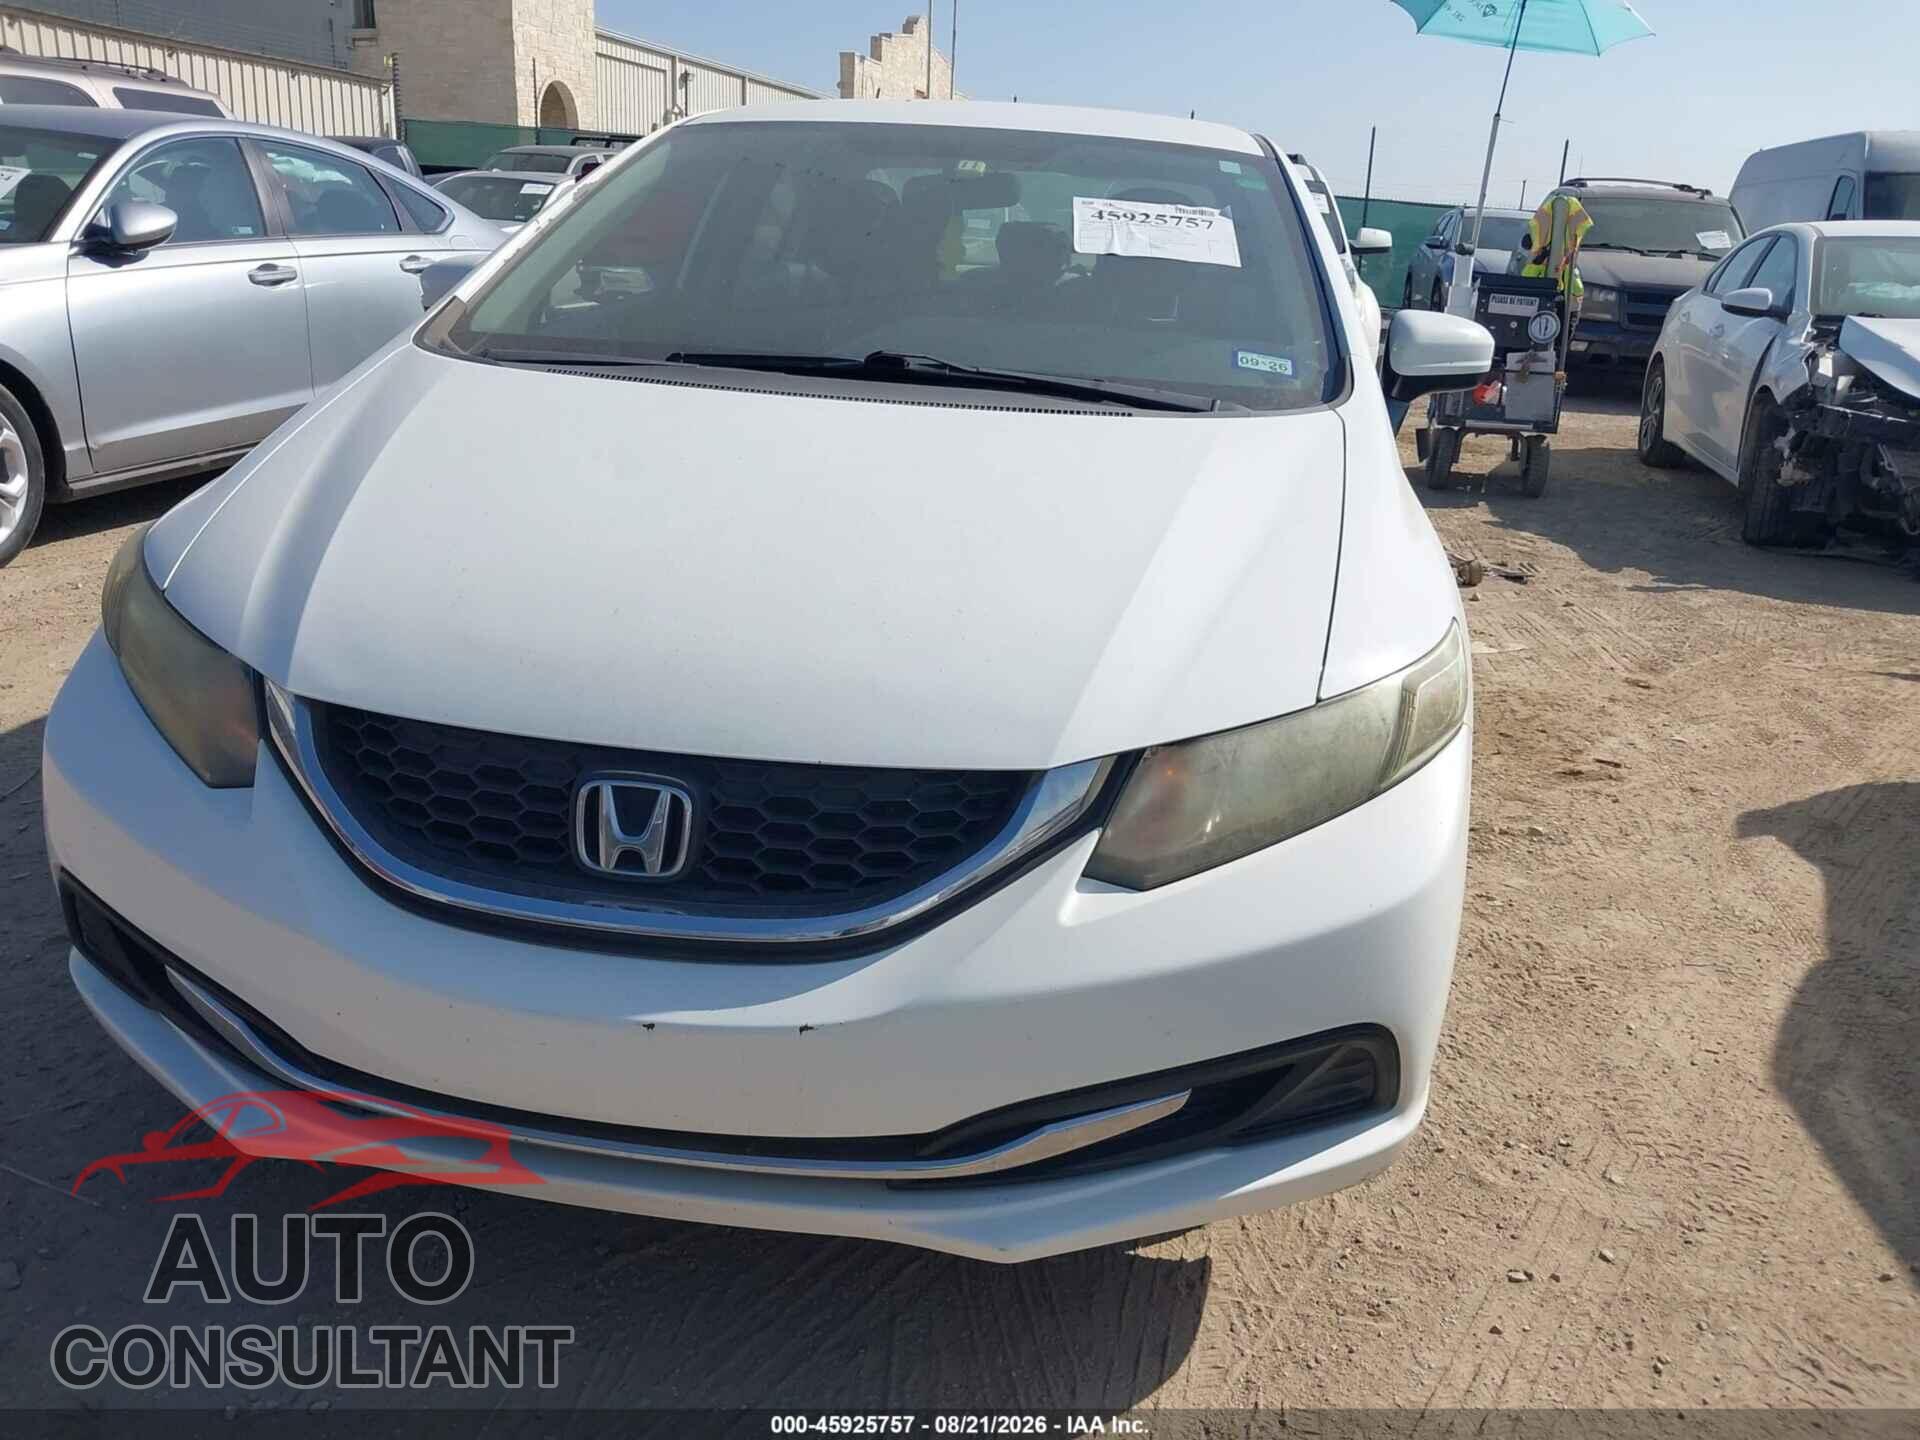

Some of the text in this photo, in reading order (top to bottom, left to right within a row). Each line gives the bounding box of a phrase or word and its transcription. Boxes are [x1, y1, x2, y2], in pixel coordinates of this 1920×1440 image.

[1090, 209, 1213, 230] 45925757
[1491, 295, 1537, 306] PLEASE BE PATIENT
